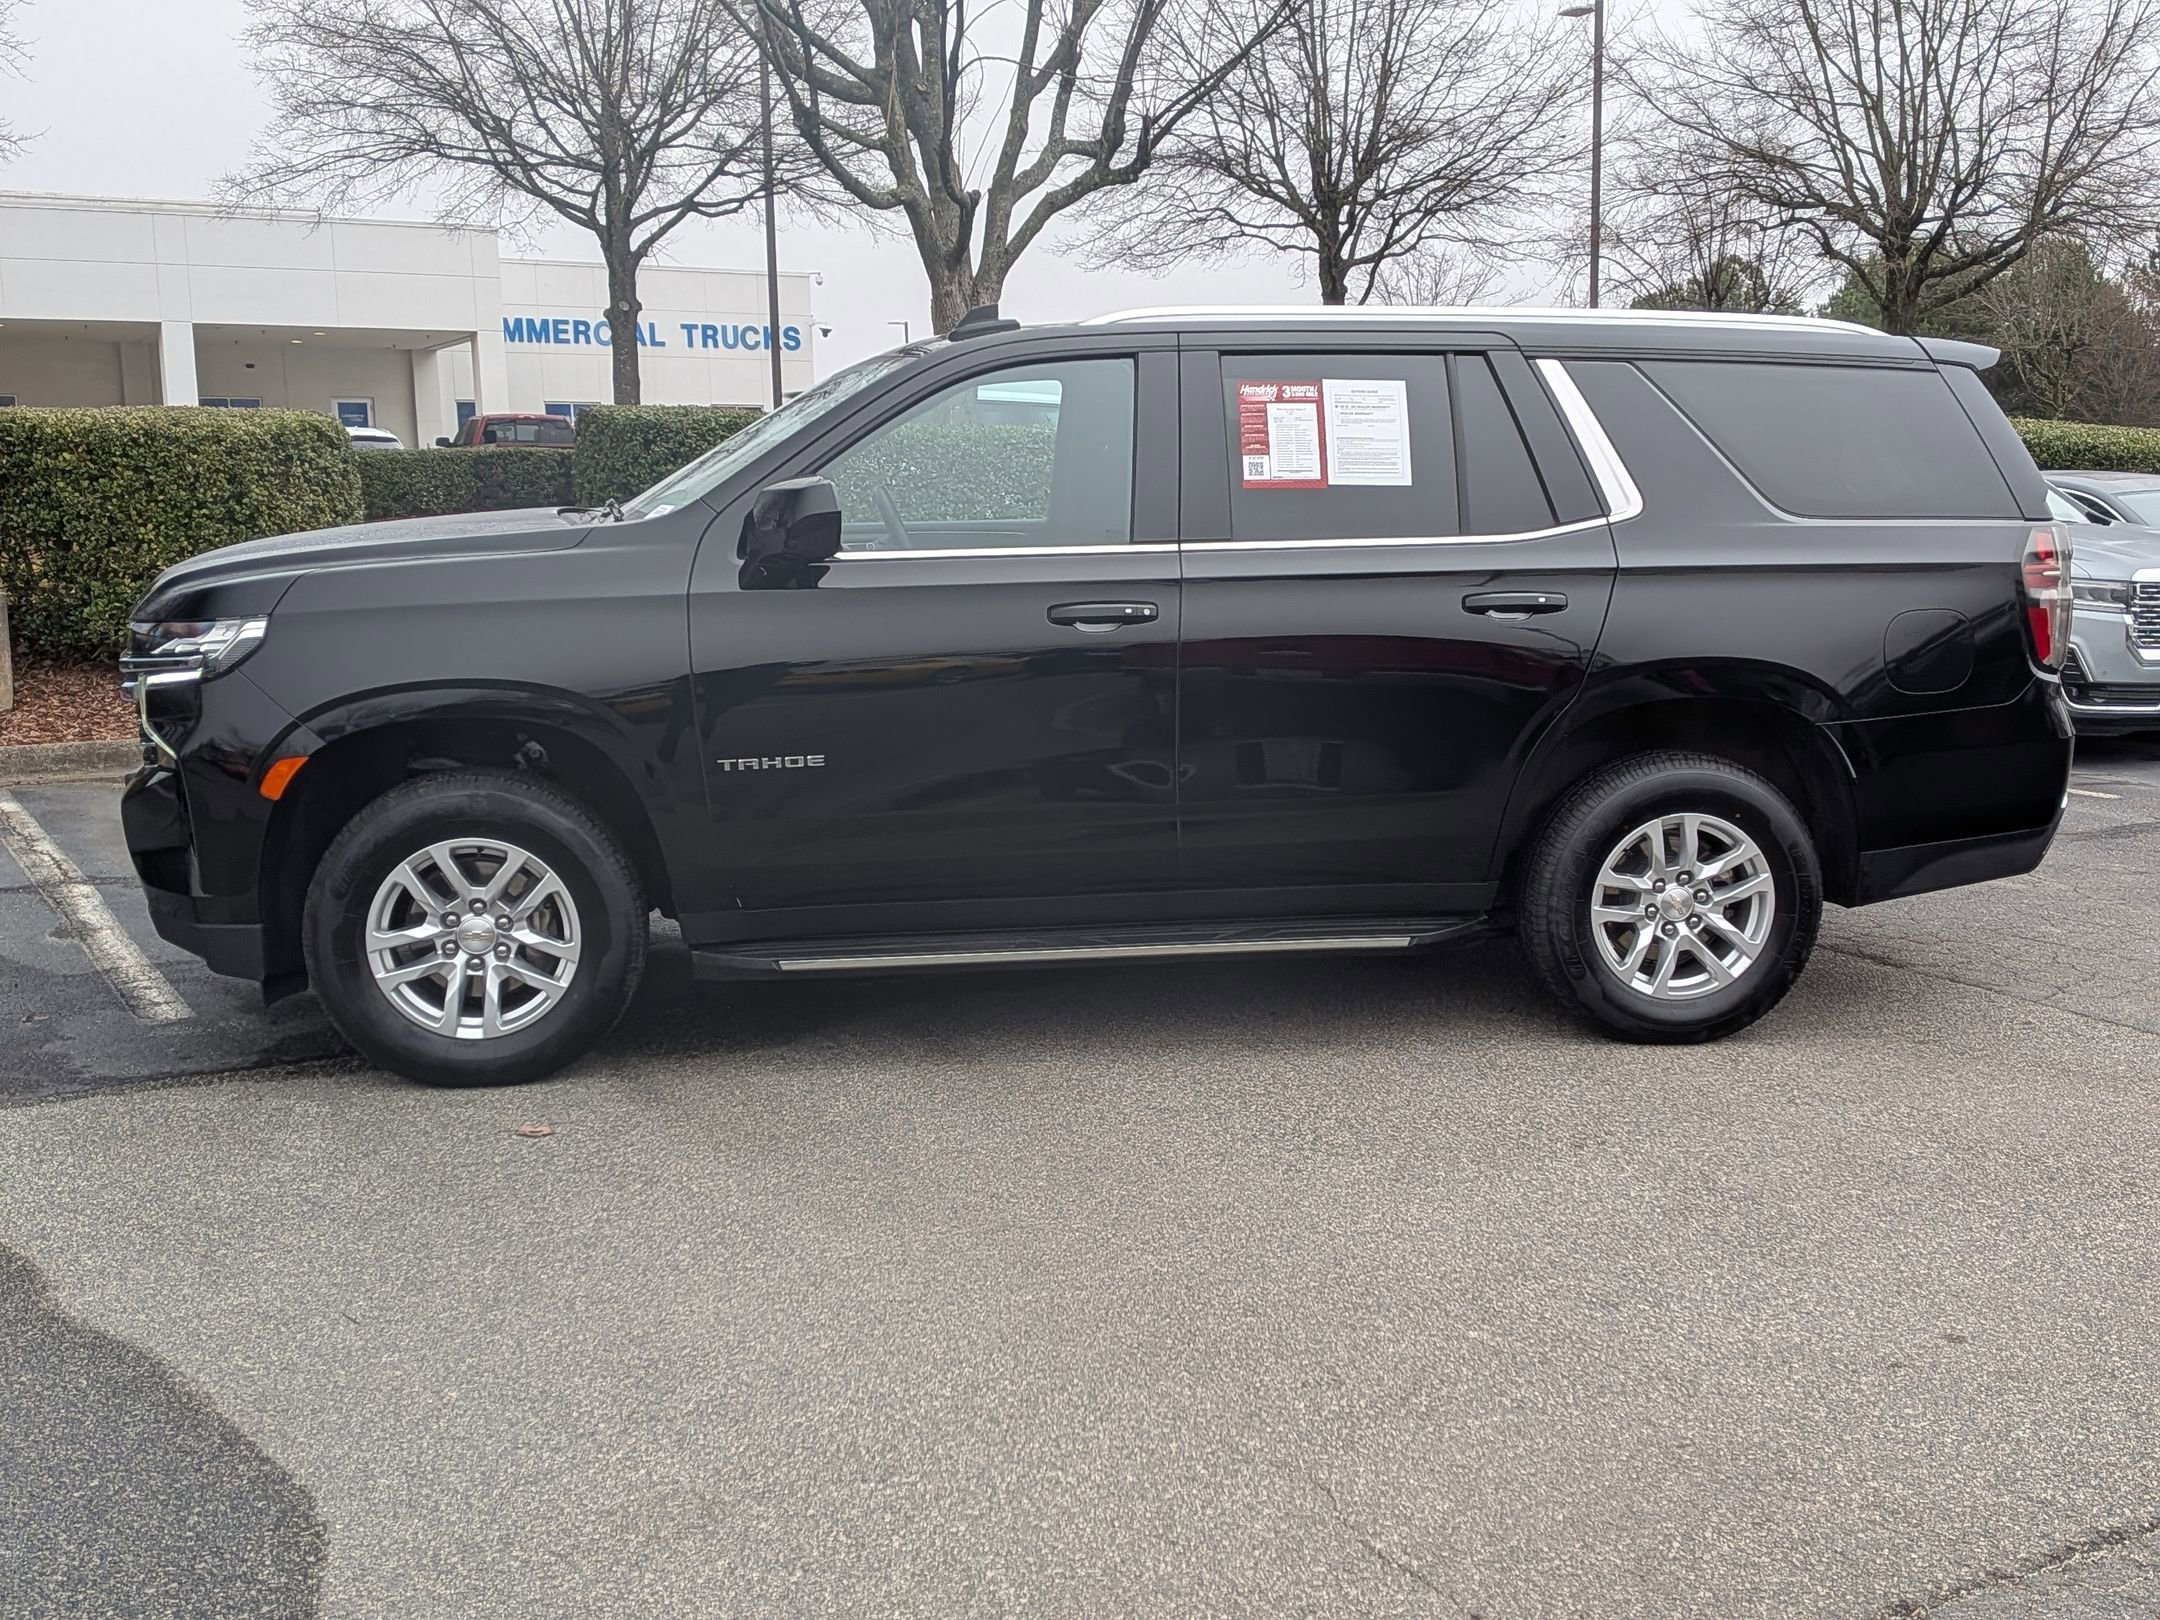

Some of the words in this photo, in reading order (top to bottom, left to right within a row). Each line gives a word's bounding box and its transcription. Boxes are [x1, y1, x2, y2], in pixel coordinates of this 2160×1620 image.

[502, 317, 666, 347] MMERCAL
[1281, 385, 1291, 398] 3
[716, 754, 826, 771] TAHOE
